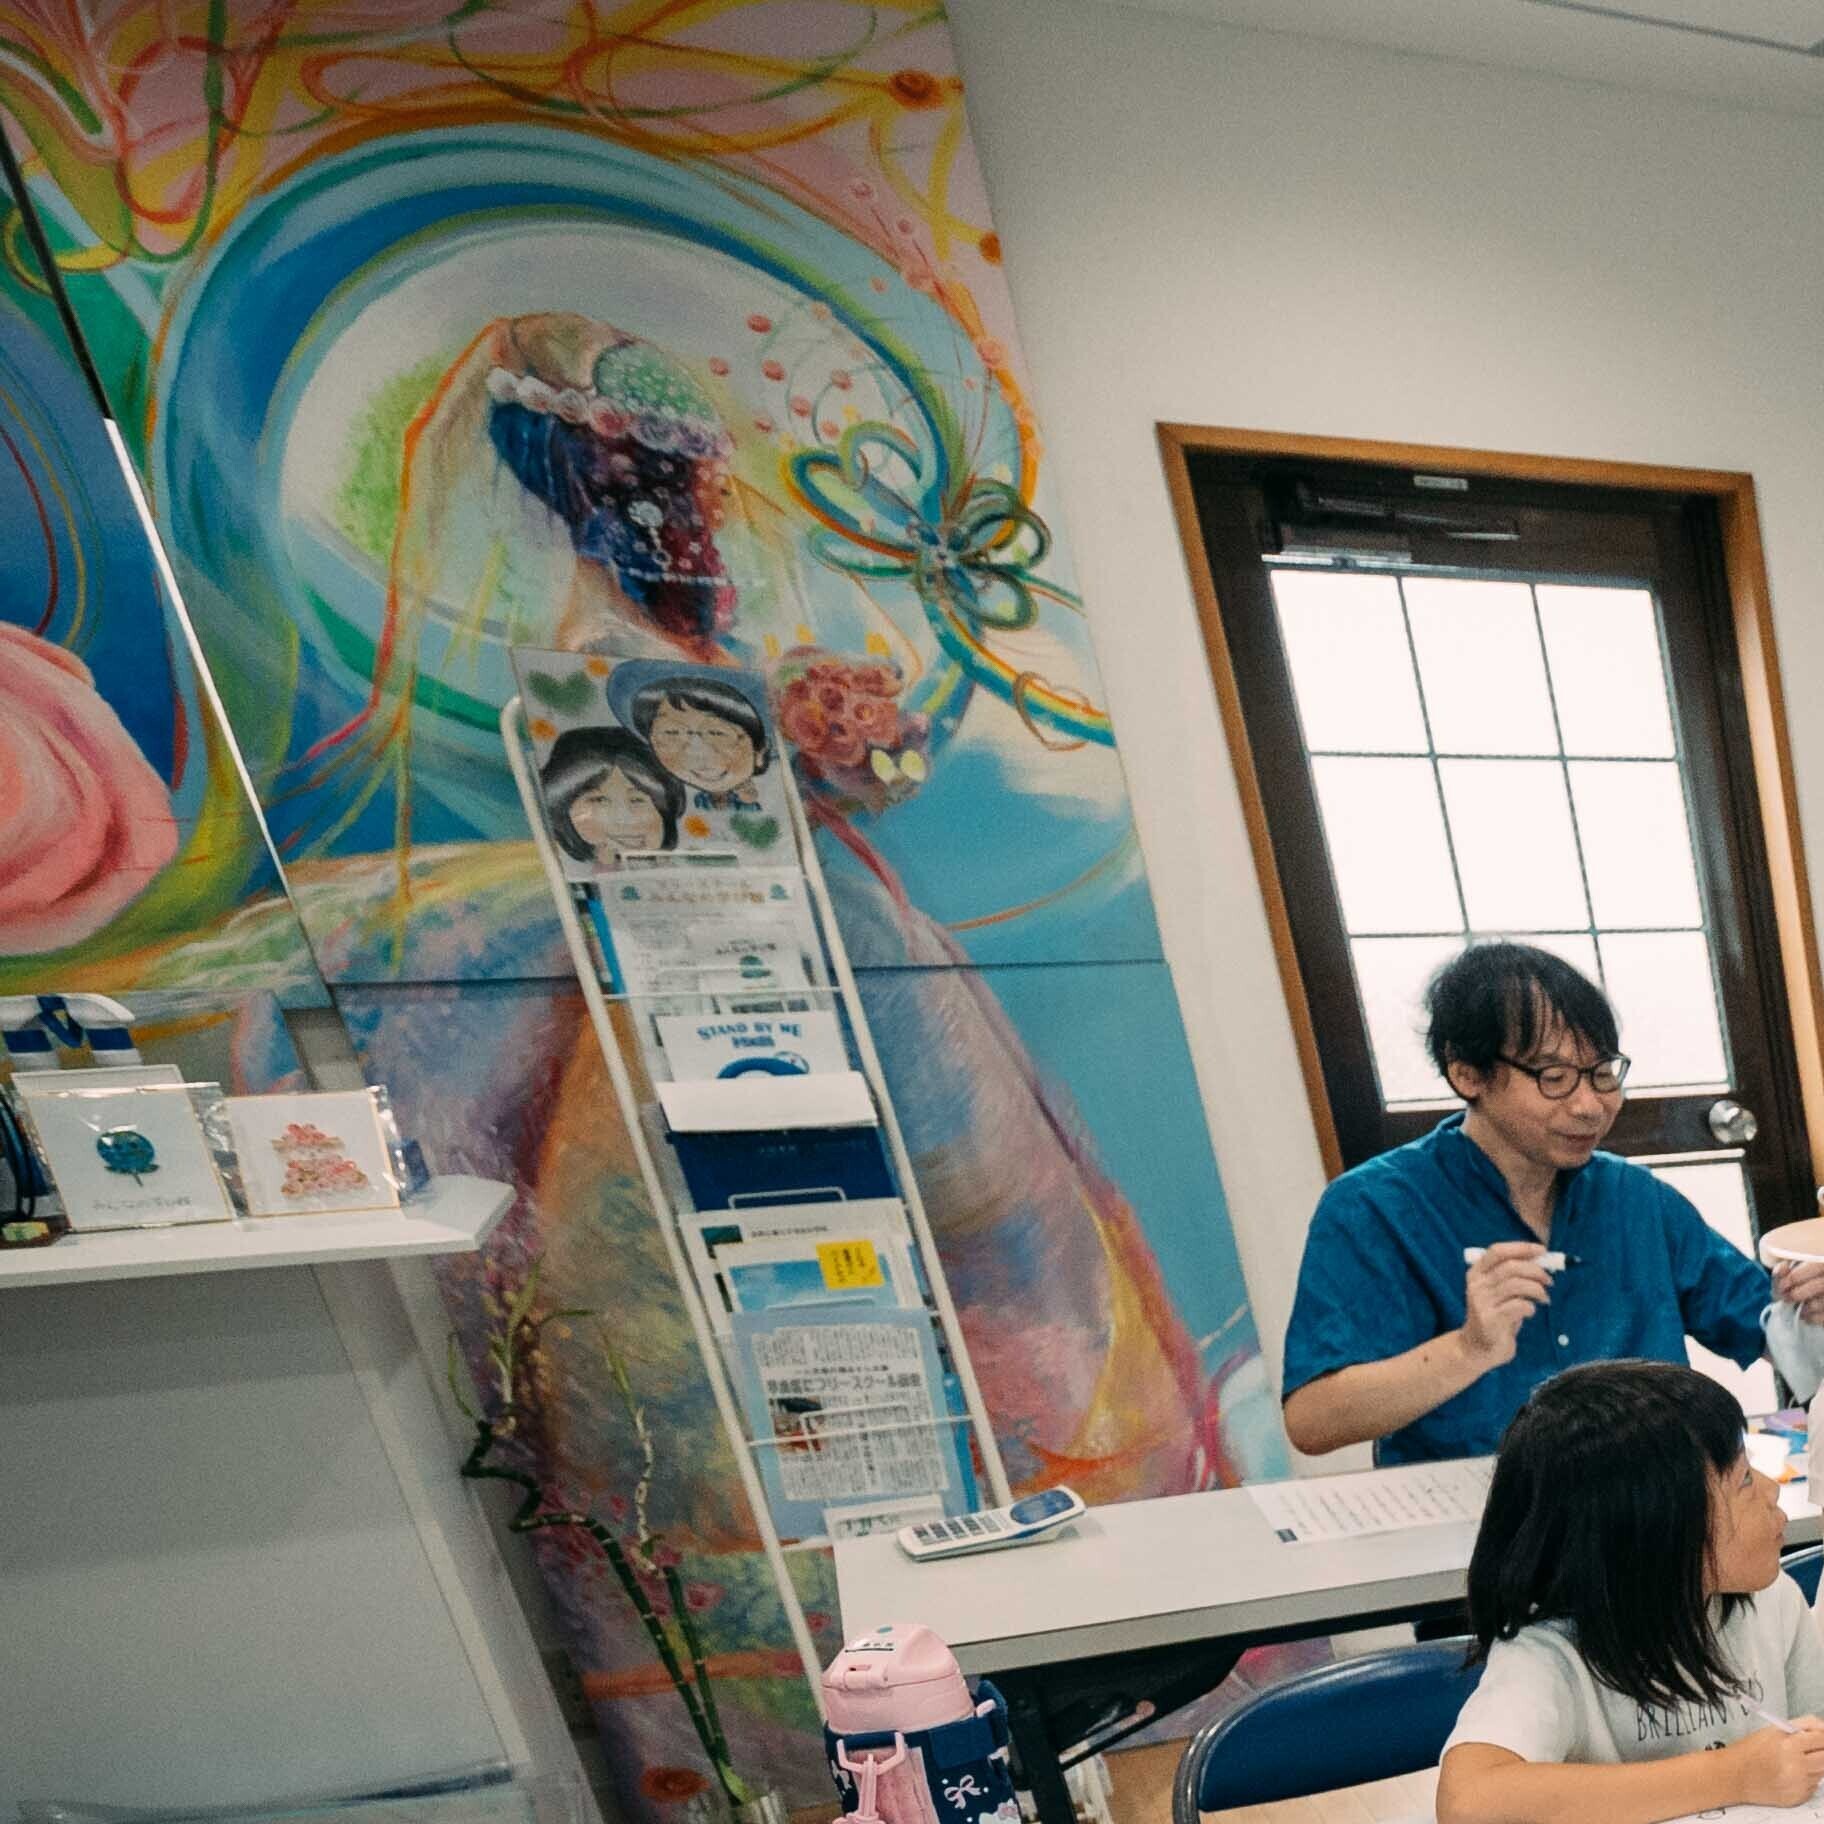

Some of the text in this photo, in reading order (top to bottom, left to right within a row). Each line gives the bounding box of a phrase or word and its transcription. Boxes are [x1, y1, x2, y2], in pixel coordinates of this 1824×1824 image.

[696, 1021, 803, 1041] STAND BY ME
